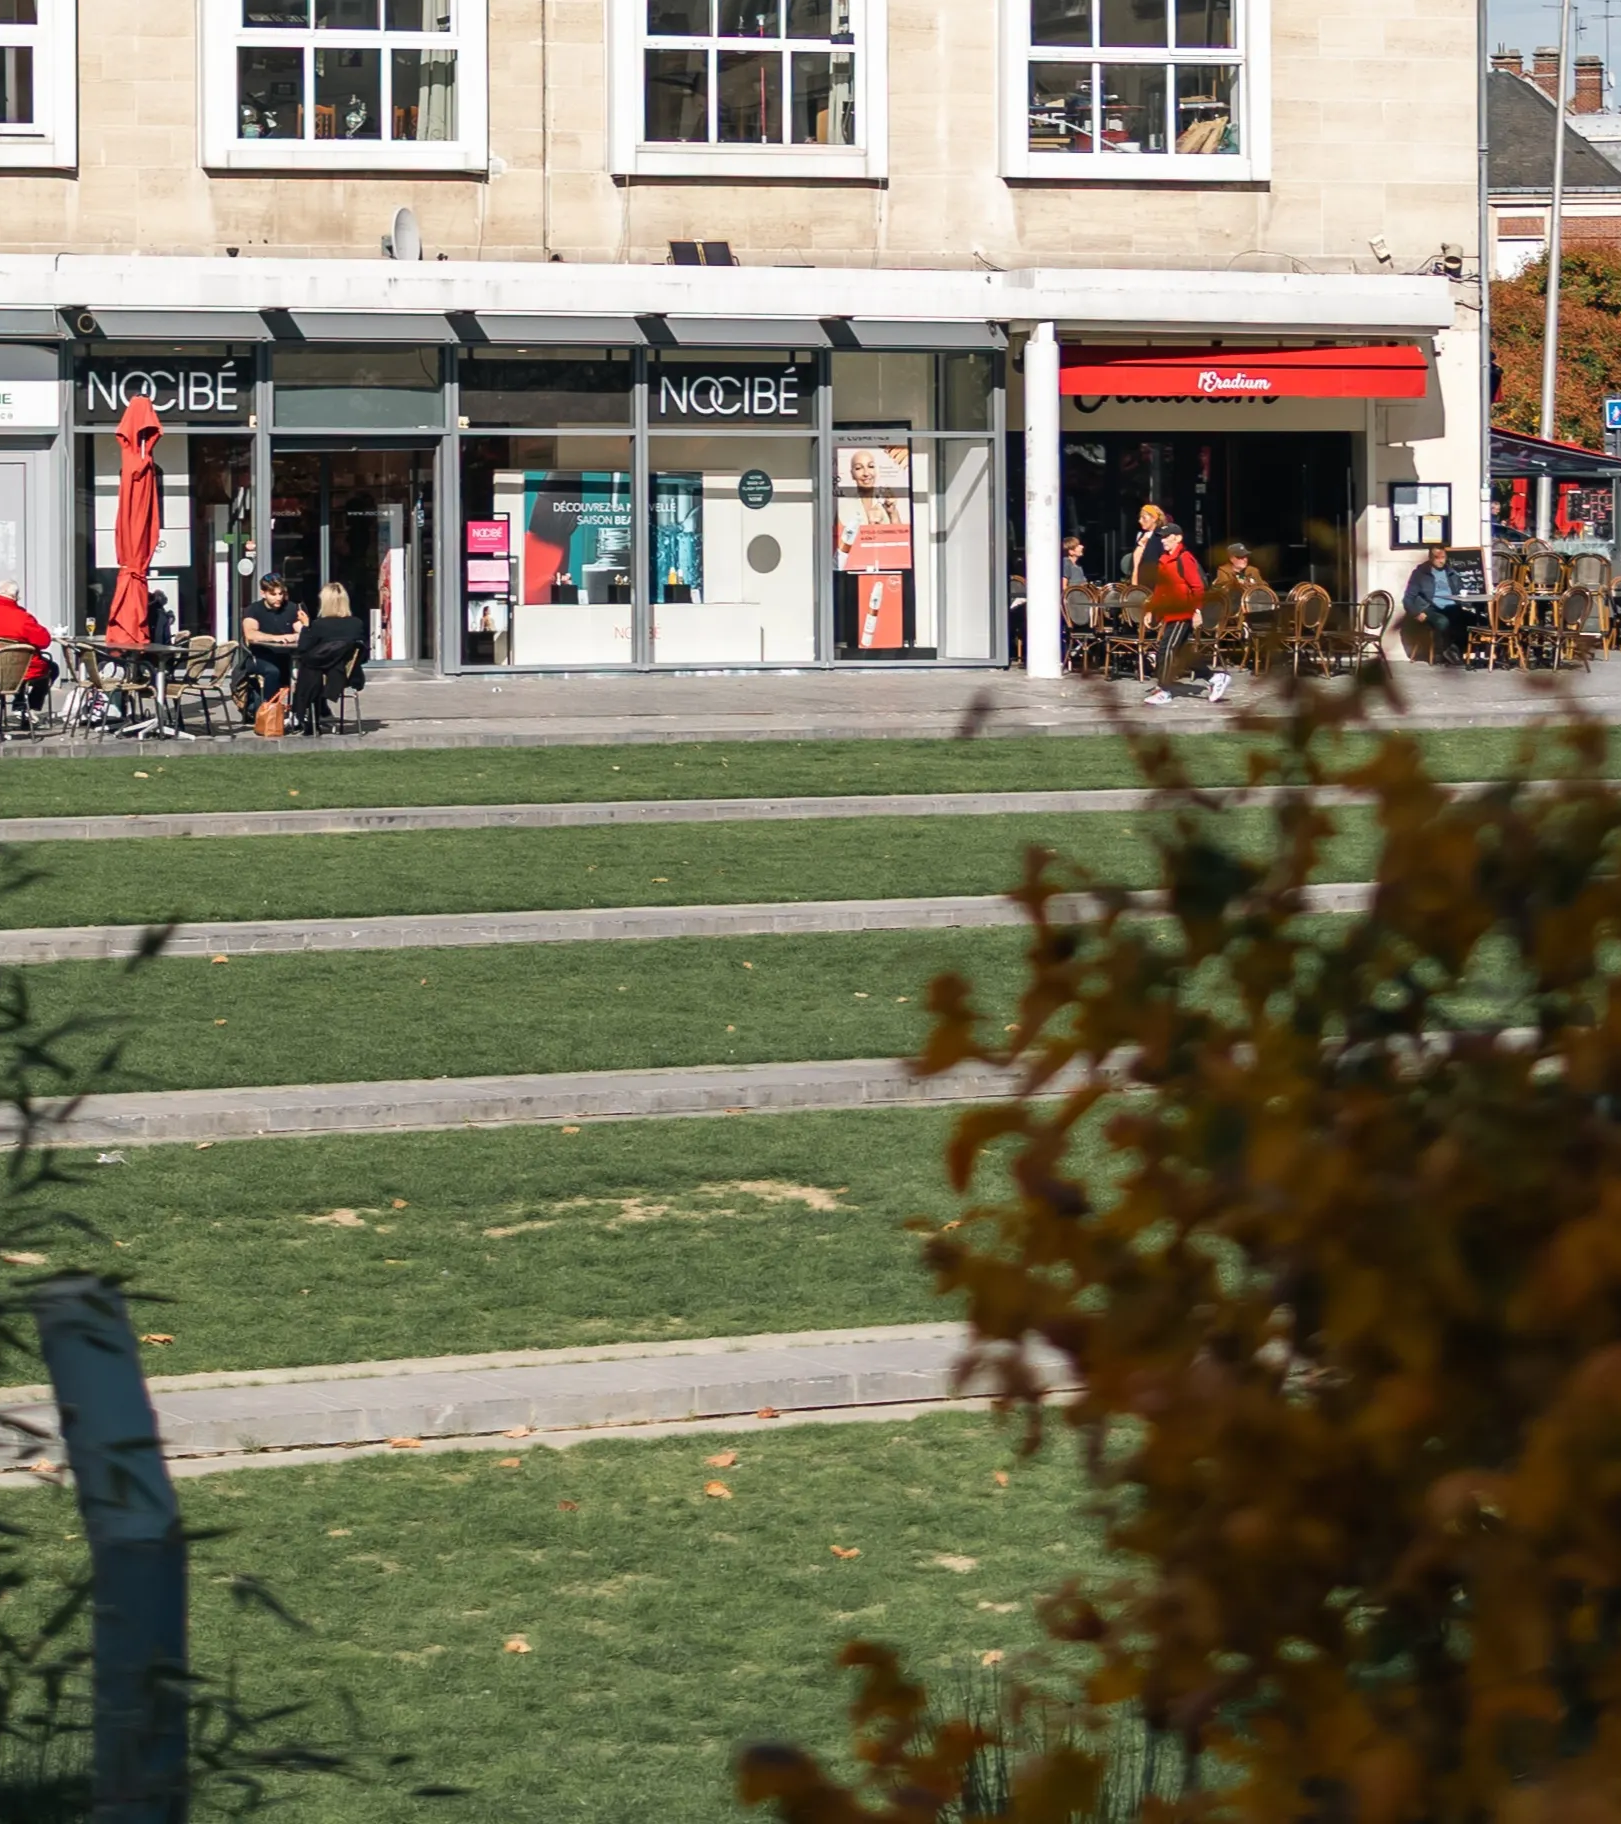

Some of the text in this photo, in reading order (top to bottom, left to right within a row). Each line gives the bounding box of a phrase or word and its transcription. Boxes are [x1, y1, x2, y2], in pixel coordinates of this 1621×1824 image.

[88, 361, 237, 411] NOCIBÉ
[660, 366, 799, 414] NOCIBÉ
[553, 501, 610, 512] DÉCOUVREZ
[577, 515, 612, 525] SAISON
